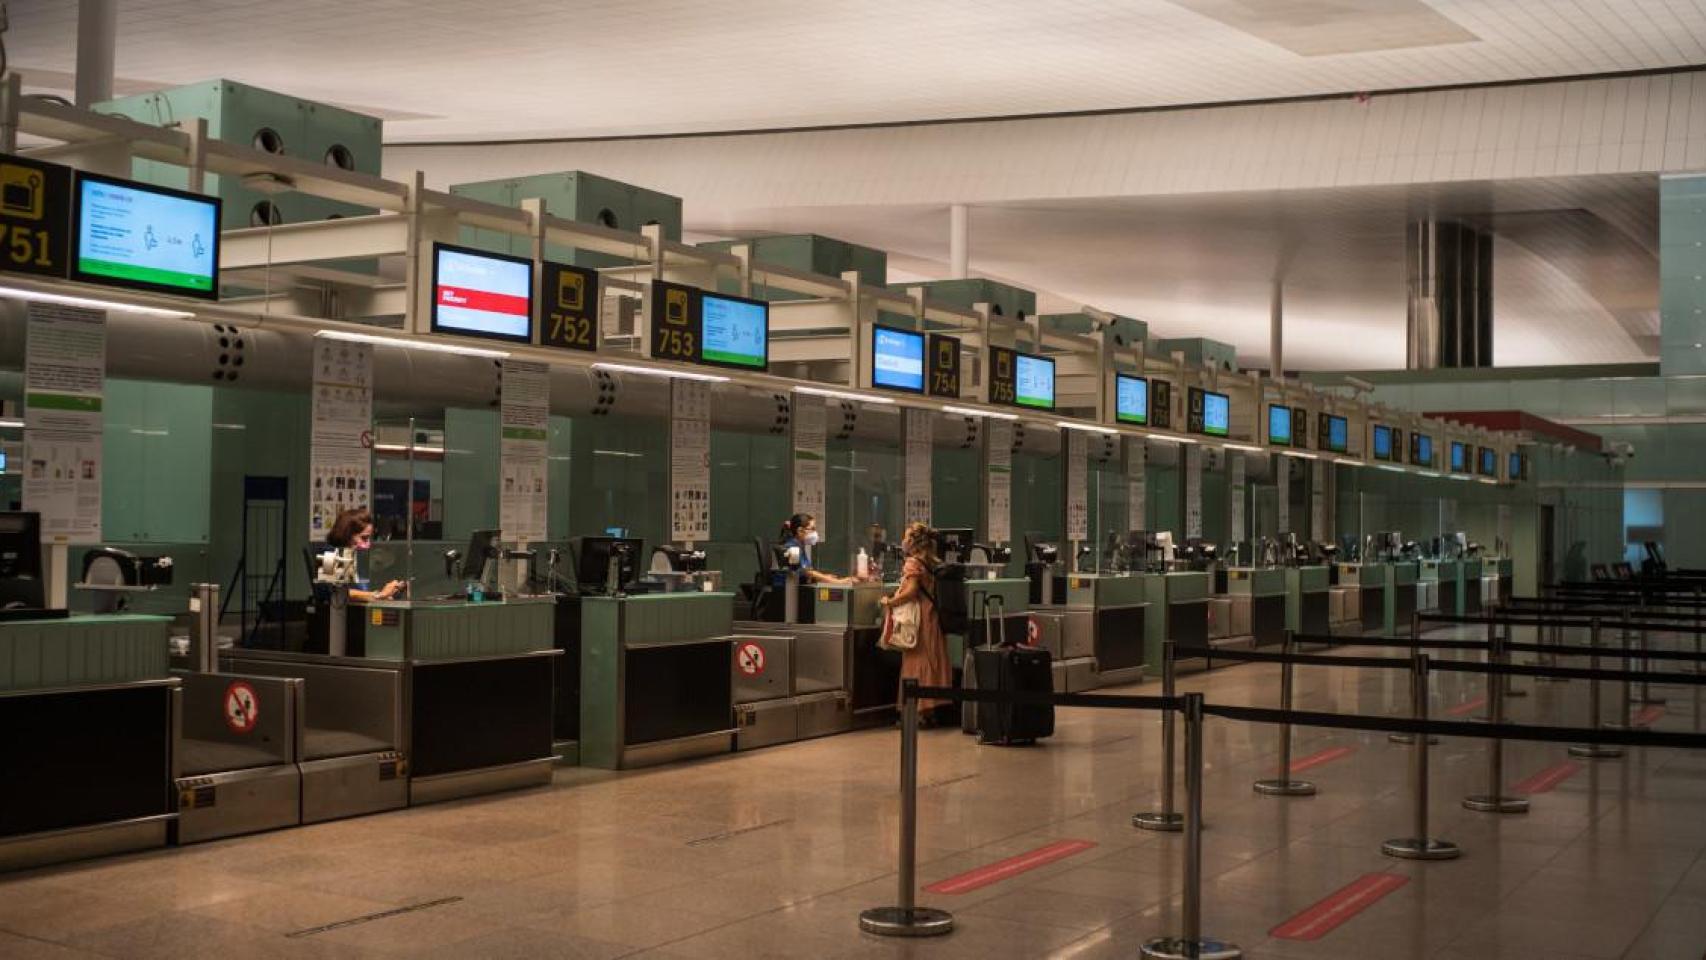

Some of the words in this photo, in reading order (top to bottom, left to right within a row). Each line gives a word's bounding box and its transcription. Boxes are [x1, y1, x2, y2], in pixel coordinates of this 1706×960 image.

[551, 315, 590, 344] 752
[660, 329, 693, 356] 753
[935, 373, 956, 393] 754
[994, 381, 1013, 401] 755
